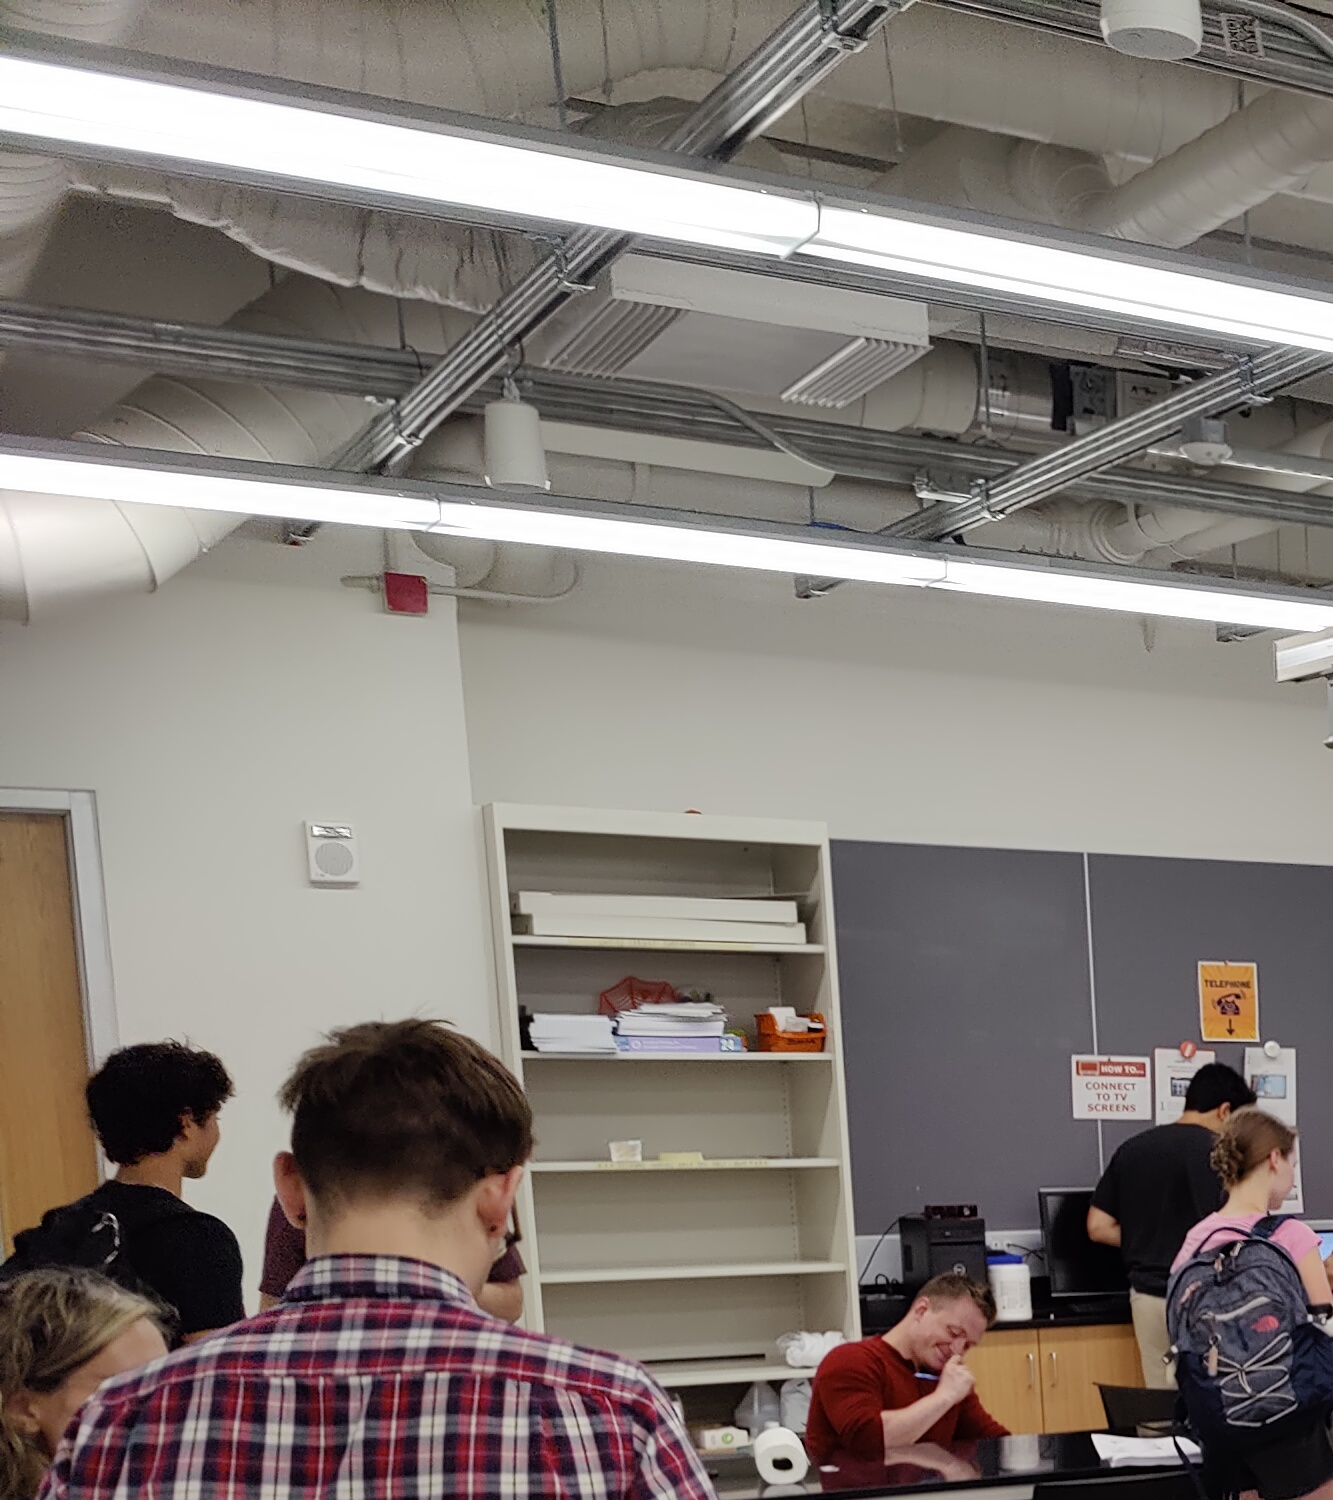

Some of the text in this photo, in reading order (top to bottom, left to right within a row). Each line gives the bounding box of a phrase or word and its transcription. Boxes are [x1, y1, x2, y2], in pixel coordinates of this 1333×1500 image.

[1203, 978, 1251, 989] TELEPHONE
[1100, 1064, 1122, 1074] HOW
[1085, 1082, 1137, 1092] CONNECT
[1096, 1093, 1127, 1101] TO TV
[1087, 1103, 1137, 1112] SCREENS
